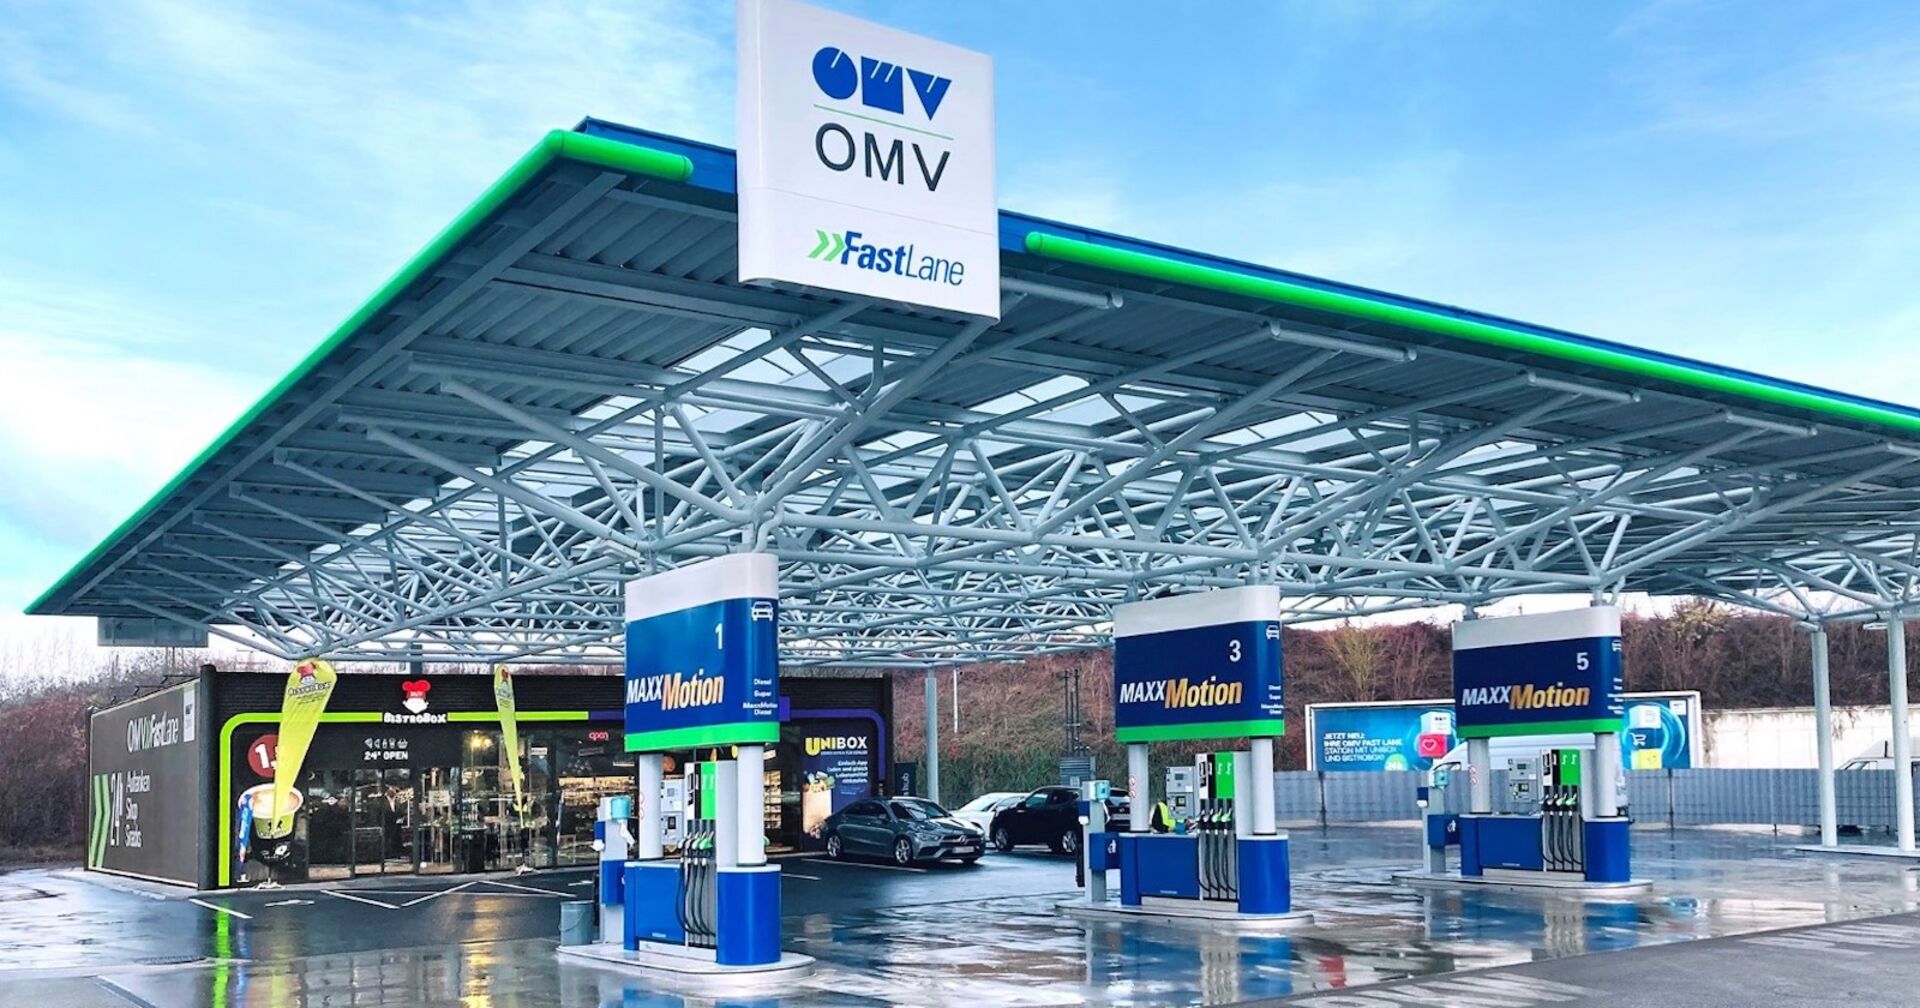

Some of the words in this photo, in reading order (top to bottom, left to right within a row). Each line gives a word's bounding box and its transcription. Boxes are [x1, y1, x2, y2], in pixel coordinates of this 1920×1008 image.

[815, 122, 951, 192] OMV
[840, 230, 965, 286] FastLane
[715, 623, 724, 650] 1
[1229, 640, 1242, 662] 3
[1576, 652, 1589, 671] 5
[383, 751, 408, 760] OPEN
[805, 737, 868, 756] UNIBOX
